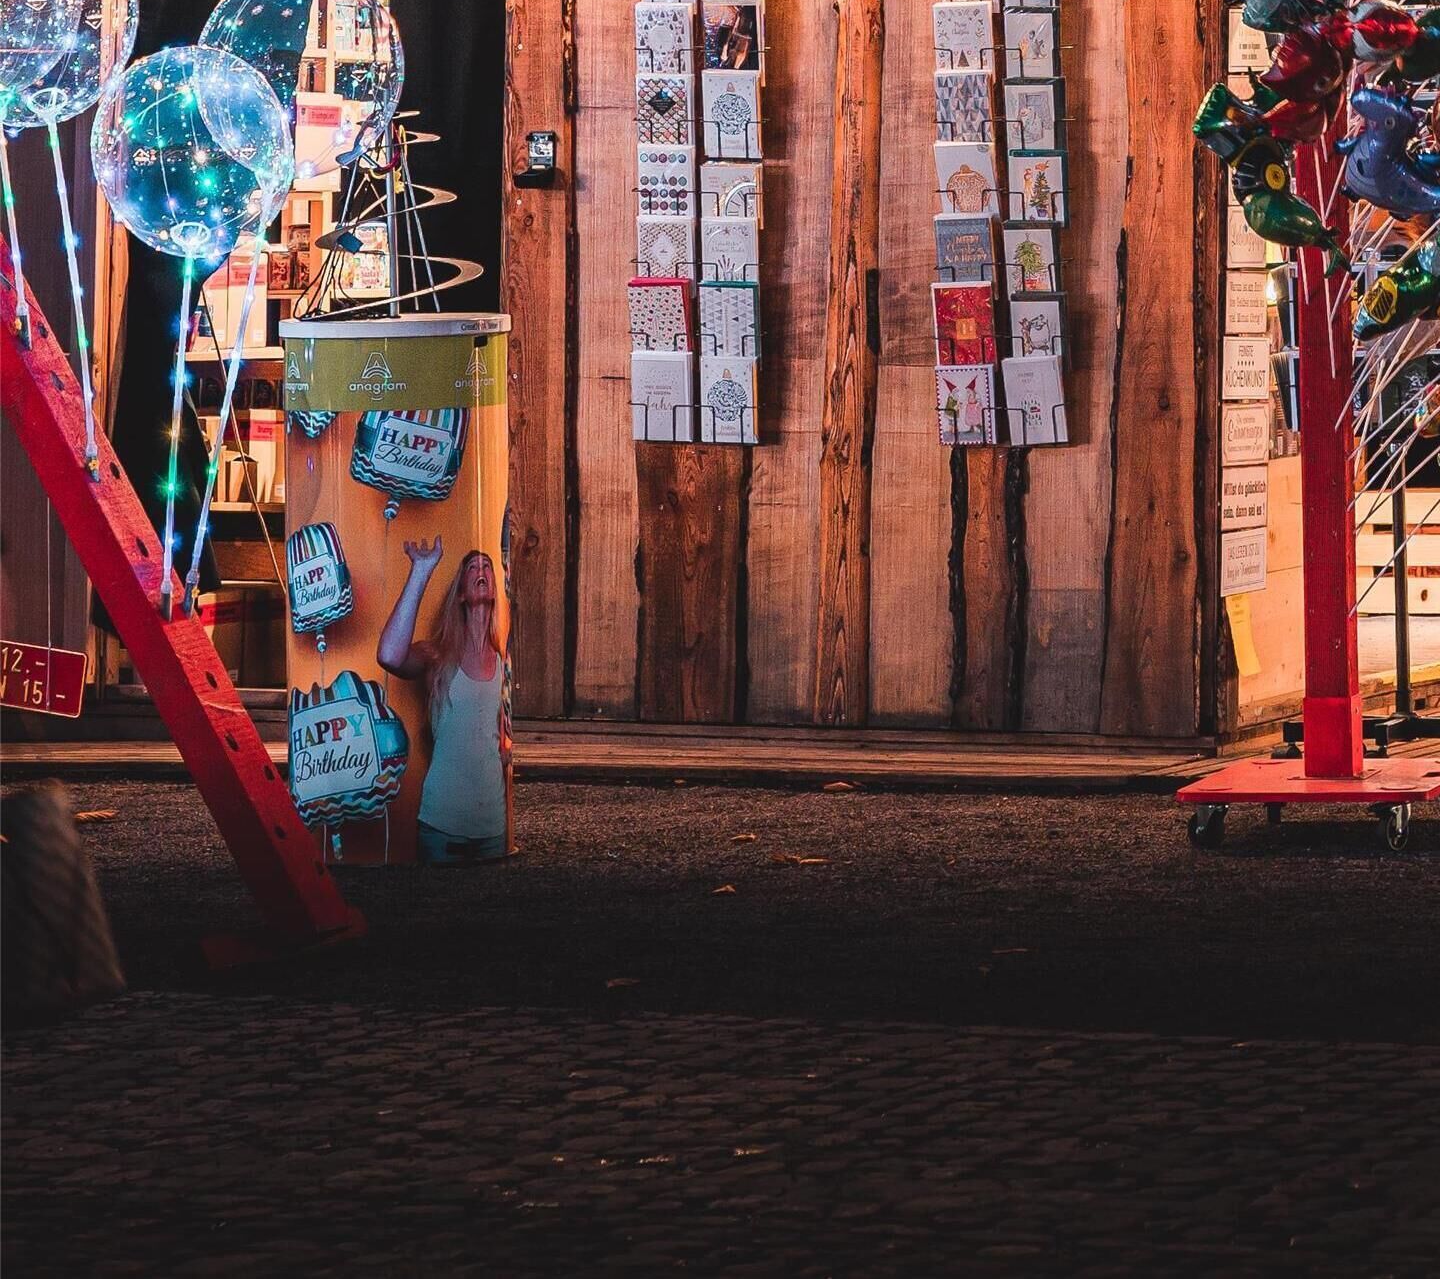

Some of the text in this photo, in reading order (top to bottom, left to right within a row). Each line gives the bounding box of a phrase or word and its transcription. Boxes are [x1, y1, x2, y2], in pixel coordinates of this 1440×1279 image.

[349, 381, 407, 394] anagram
[1225, 366, 1266, 388] KÜCHENKUNST
[381, 427, 449, 457] HAPPY
[374, 443, 445, 478] Birthday
[294, 562, 332, 591] HAPPY
[296, 583, 337, 607] Birthday
[293, 713, 365, 753] HAPPY
[296, 745, 373, 783] Birthday
